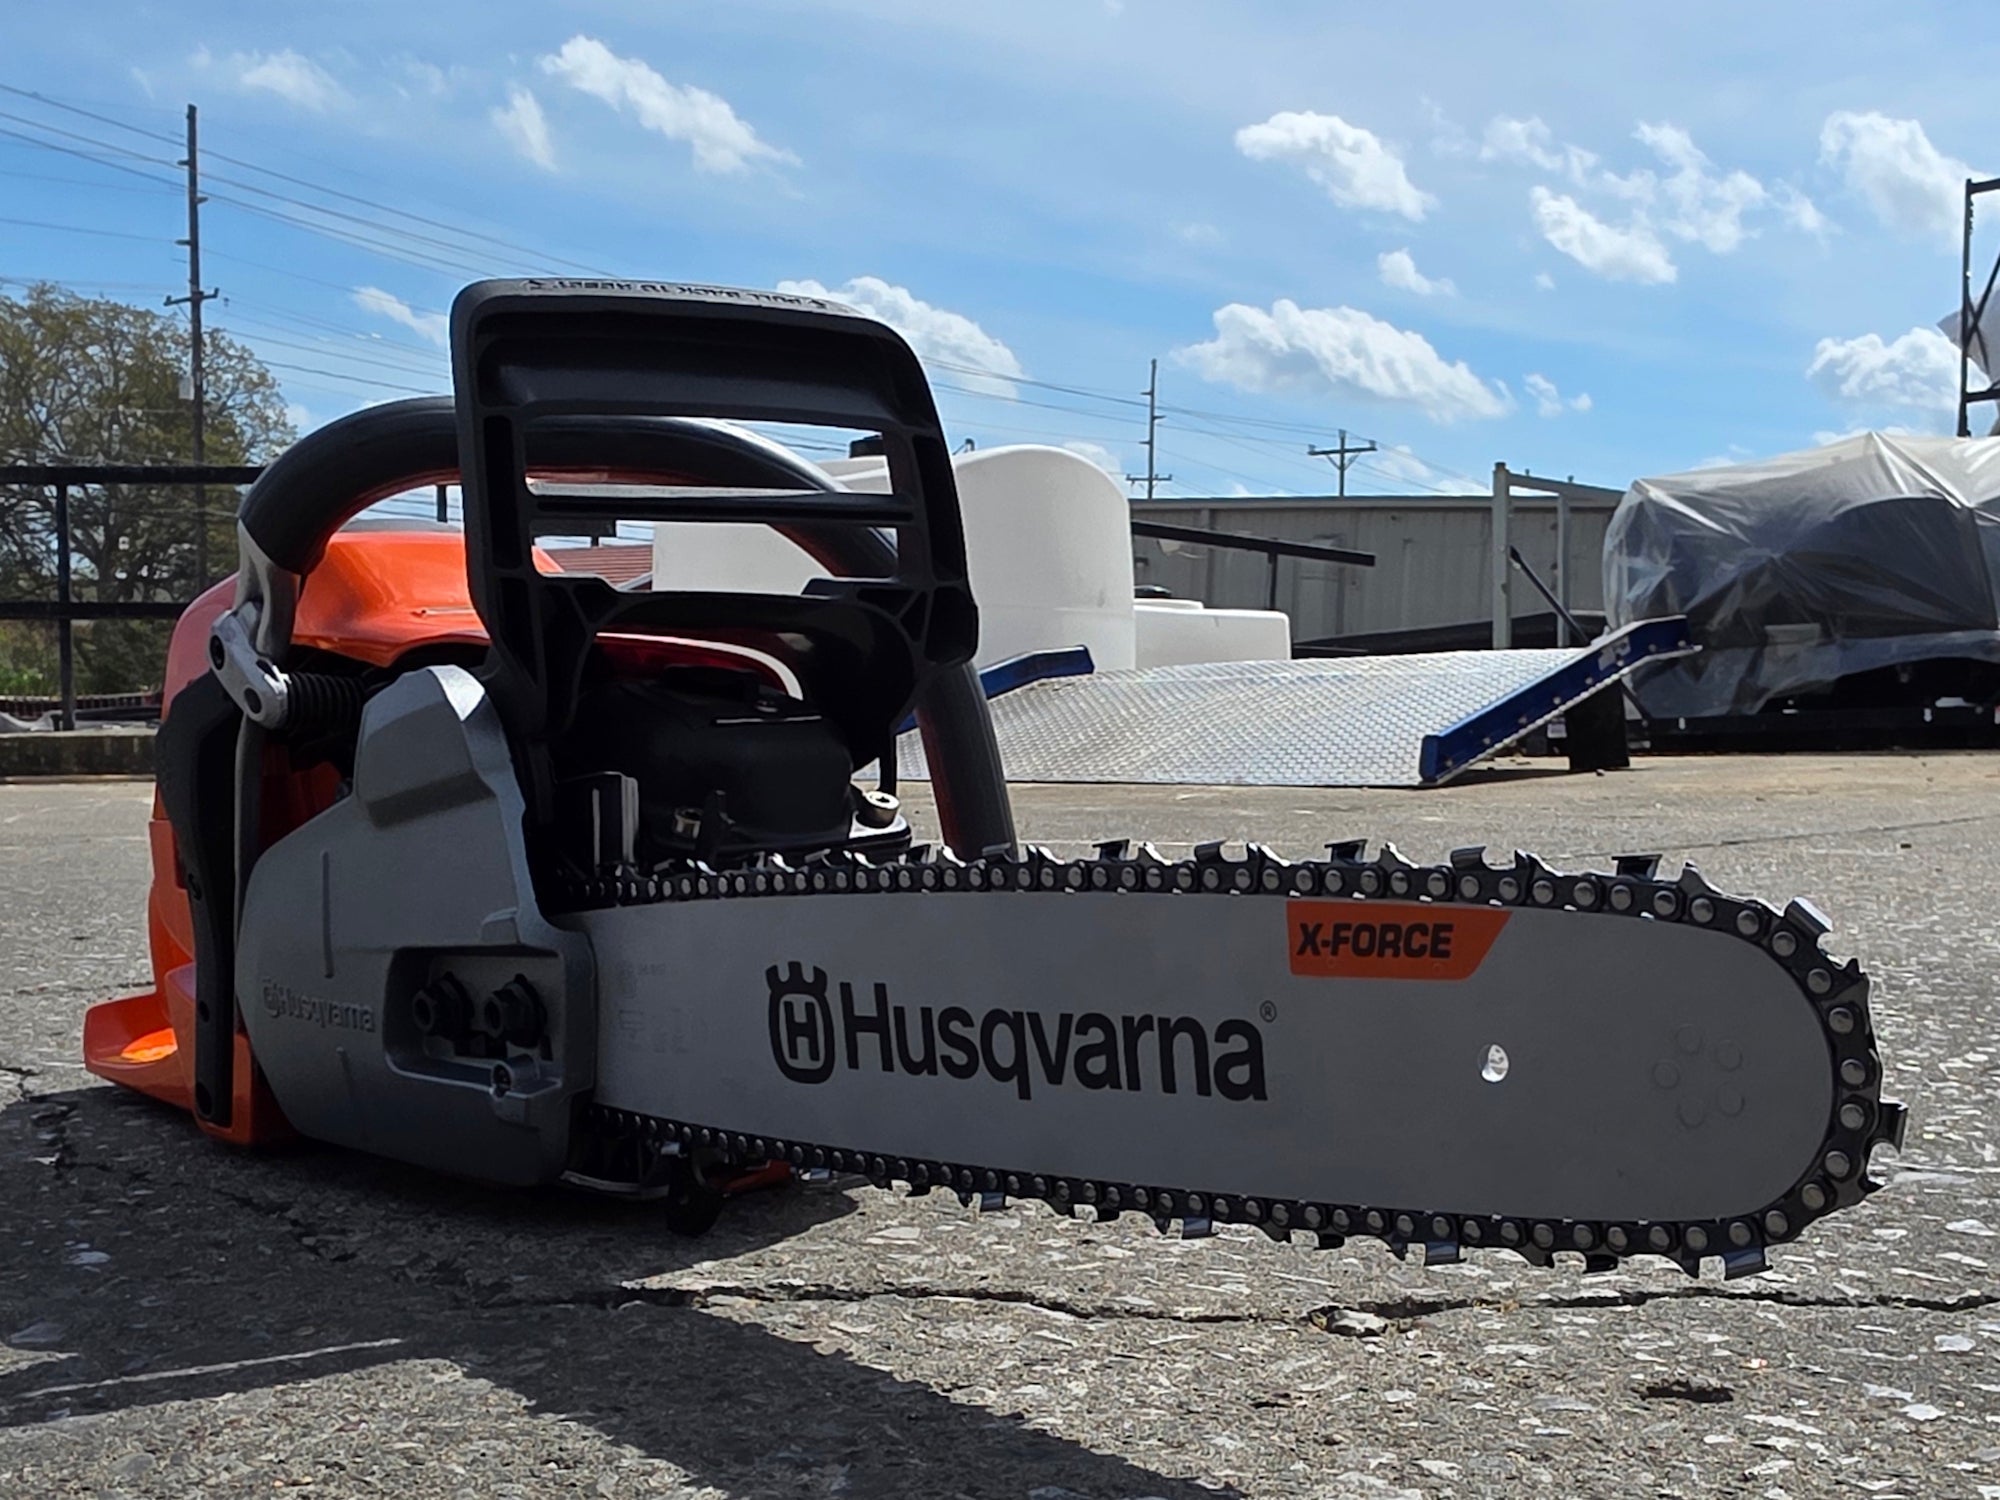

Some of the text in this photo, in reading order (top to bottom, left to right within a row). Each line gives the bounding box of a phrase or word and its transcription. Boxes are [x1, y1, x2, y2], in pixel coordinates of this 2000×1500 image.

[677, 286, 741, 298] BACK
[1296, 922, 1455, 959] X-FORCE
[278, 986, 376, 1033] Husqvarna
